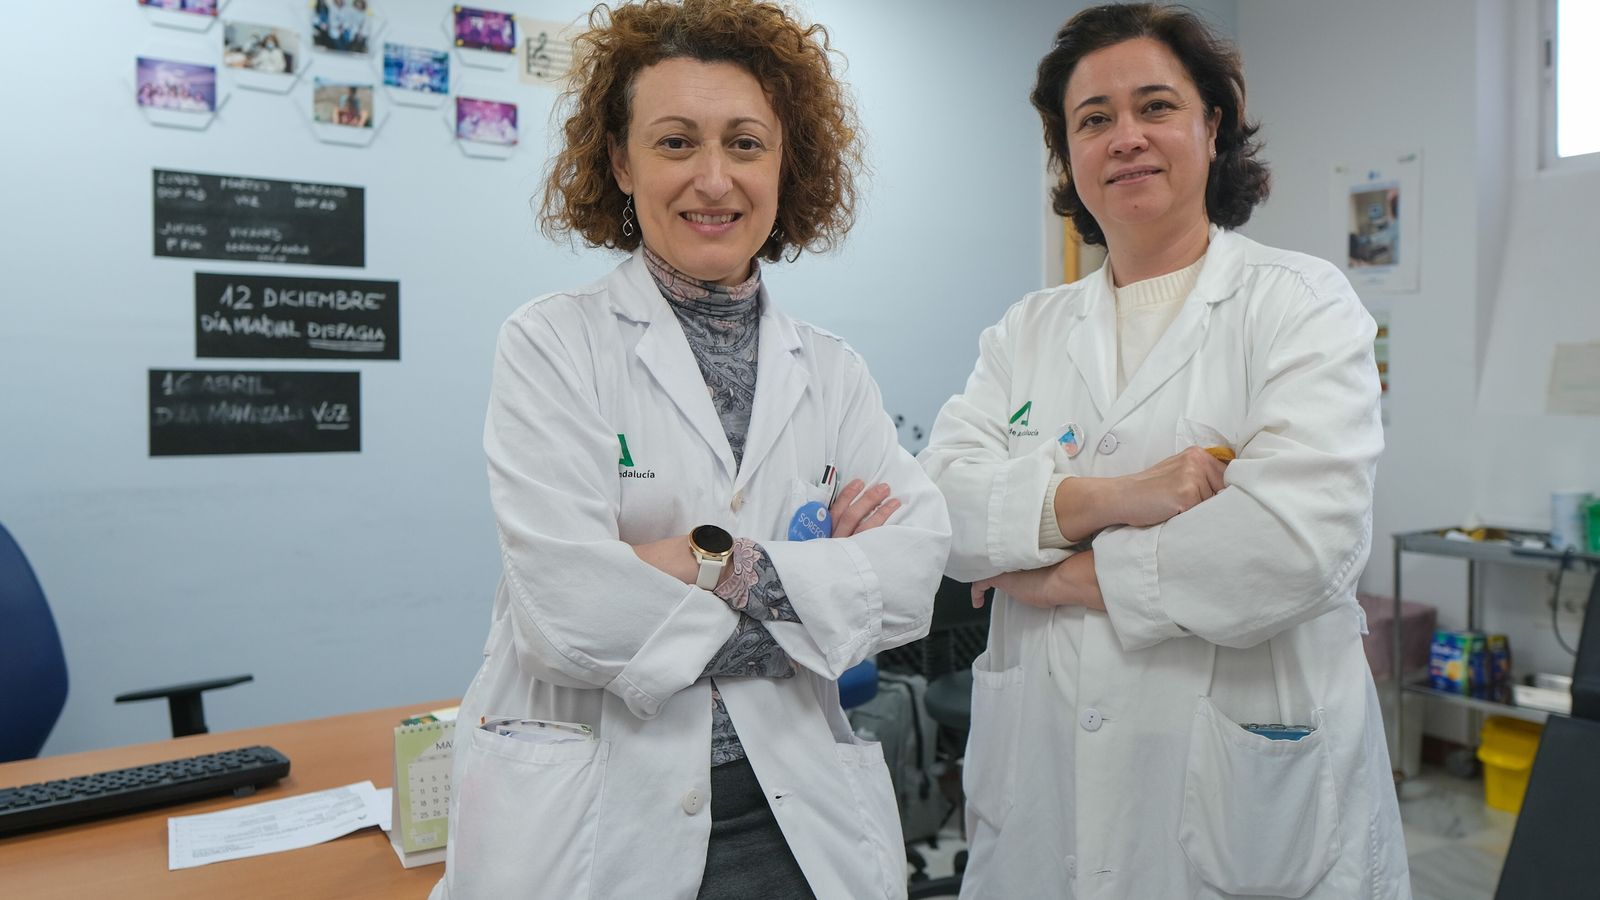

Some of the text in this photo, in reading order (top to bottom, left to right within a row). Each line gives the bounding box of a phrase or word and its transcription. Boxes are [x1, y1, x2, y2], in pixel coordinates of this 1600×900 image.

[219, 284, 387, 311] 12 DICIEMBRE
[307, 321, 387, 341] DISFAGIA
[311, 400, 351, 423] VOZ
[799, 512, 827, 538] SOREFO
[435, 740, 454, 751] MA
